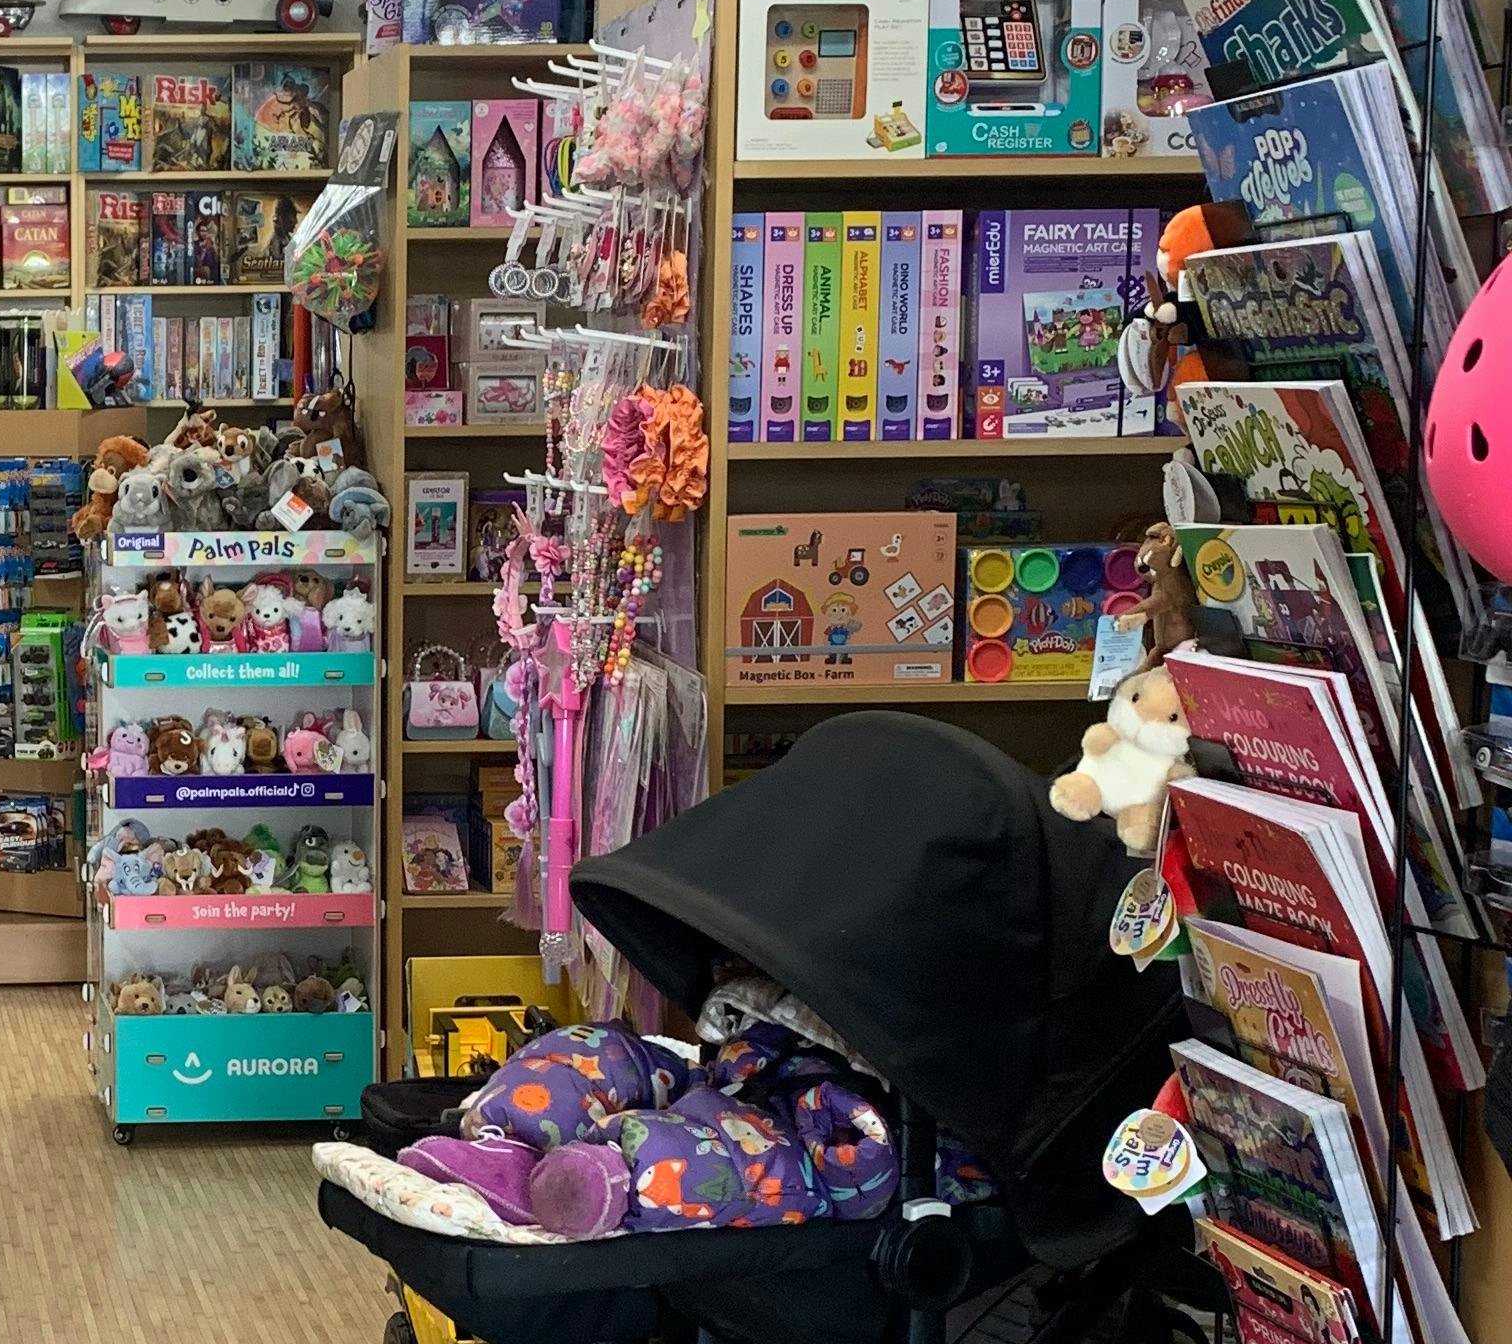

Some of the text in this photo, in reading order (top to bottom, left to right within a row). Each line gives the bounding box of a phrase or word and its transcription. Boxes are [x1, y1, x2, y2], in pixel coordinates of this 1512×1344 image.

[155, 75, 217, 105] Risk
[987, 137, 1052, 149] REGISTER
[14, 227, 58, 241] CATAN
[1024, 223, 1142, 240] FAIRY TALES
[1023, 242, 1141, 254] MAGNETIC ART CAE
[858, 250, 869, 311] ALPHABET
[939, 248, 950, 307] FASHION
[739, 265, 754, 336] SHAPES
[781, 264, 794, 335] DRESS UP
[820, 265, 830, 321] ANIMAL
[898, 263, 909, 335] DINO WORLD
[118, 536, 160, 550] Original
[1029, 636, 1076, 653] Play-Doh
[186, 662, 300, 680] Collect them all!
[739, 670, 791, 683] Magnetic
[793, 670, 816, 680] Box
[825, 668, 855, 680] Farm
[1224, 732, 1319, 771] COLOURING
[175, 784, 289, 801] @palmpals.official
[1224, 860, 1317, 909] COLOURING
[192, 902, 295, 921] Join the party!
[227, 1058, 318, 1076] AURORA
